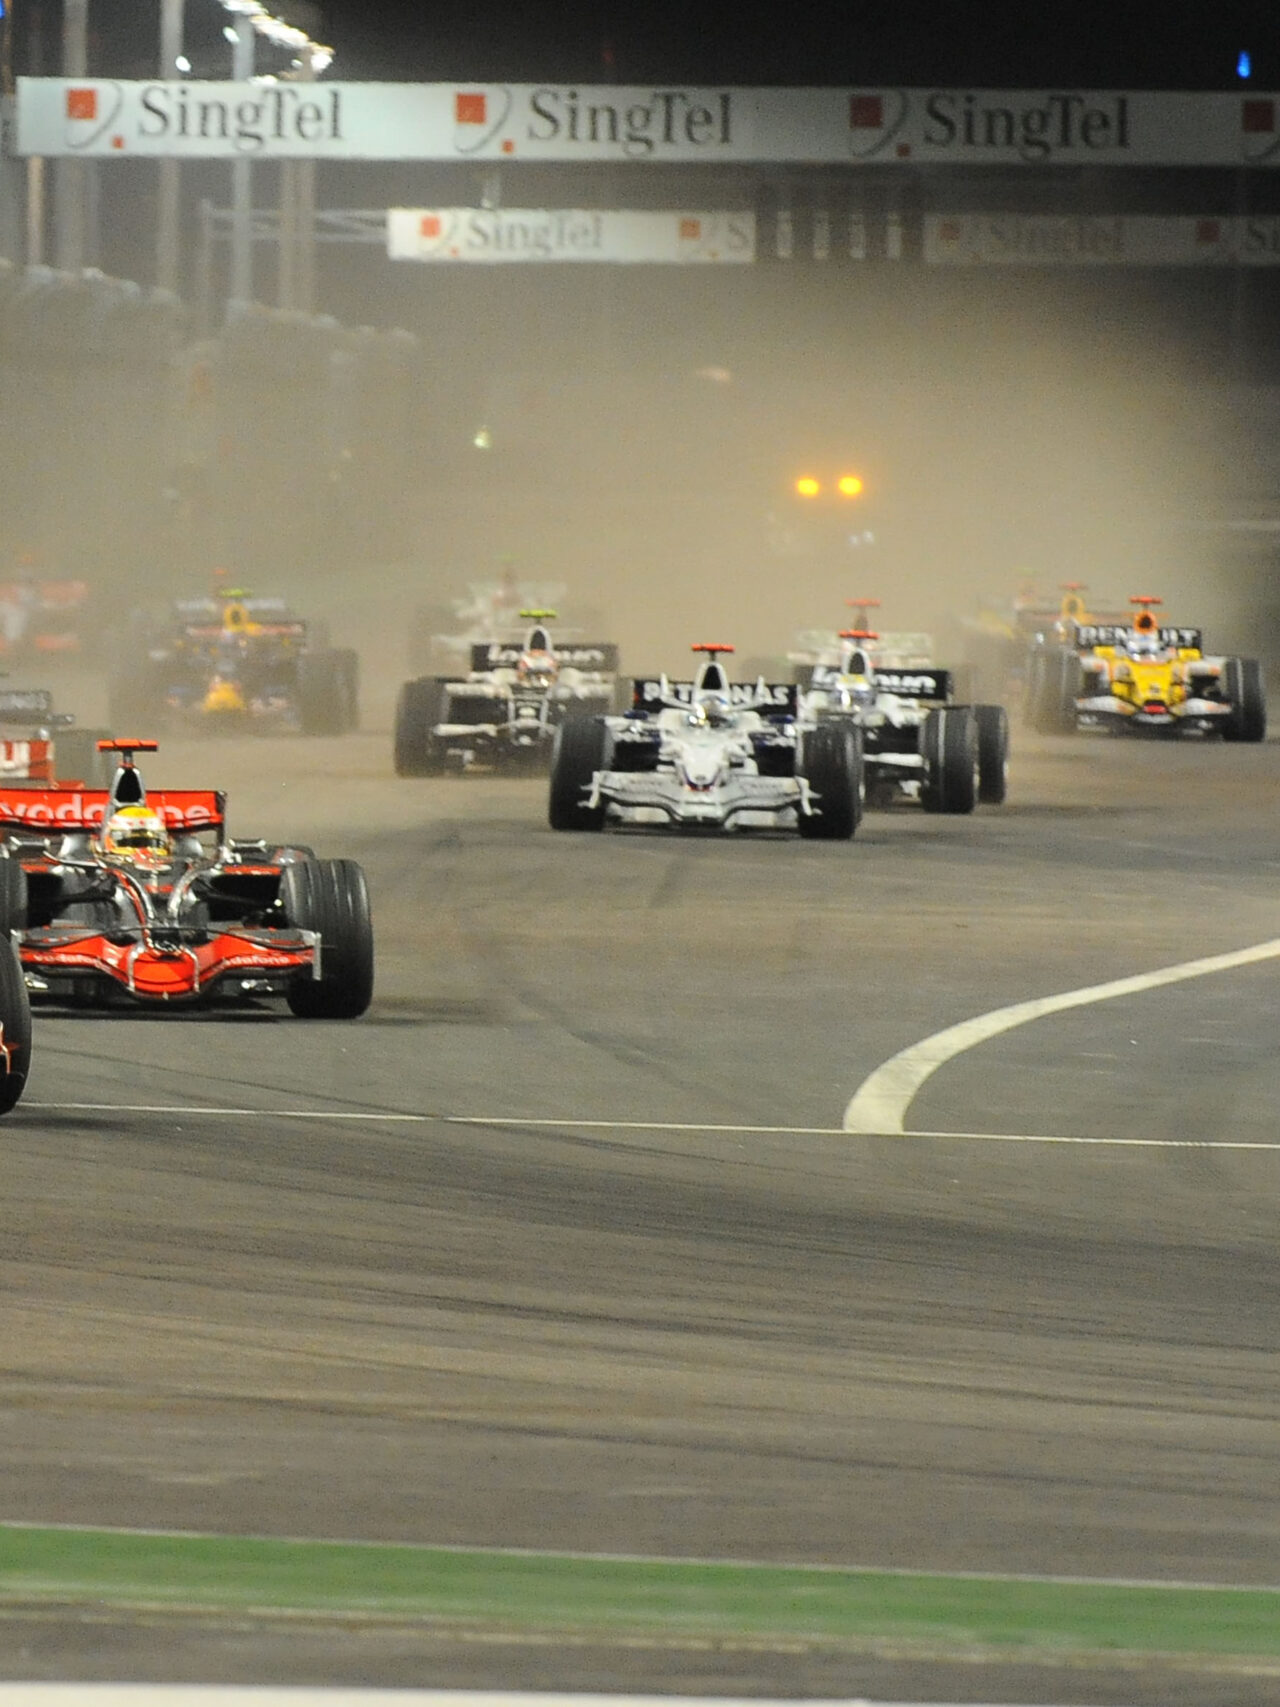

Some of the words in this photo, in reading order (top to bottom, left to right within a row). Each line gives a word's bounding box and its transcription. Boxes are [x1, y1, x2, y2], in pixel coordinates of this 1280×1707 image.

[138, 85, 342, 151] SingTel
[528, 89, 732, 157] SingTel
[923, 95, 1129, 161] SingTel
[468, 214, 603, 257] SingTel
[1080, 626, 1197, 648] RENLT
[643, 682, 789, 705] PETNAS
